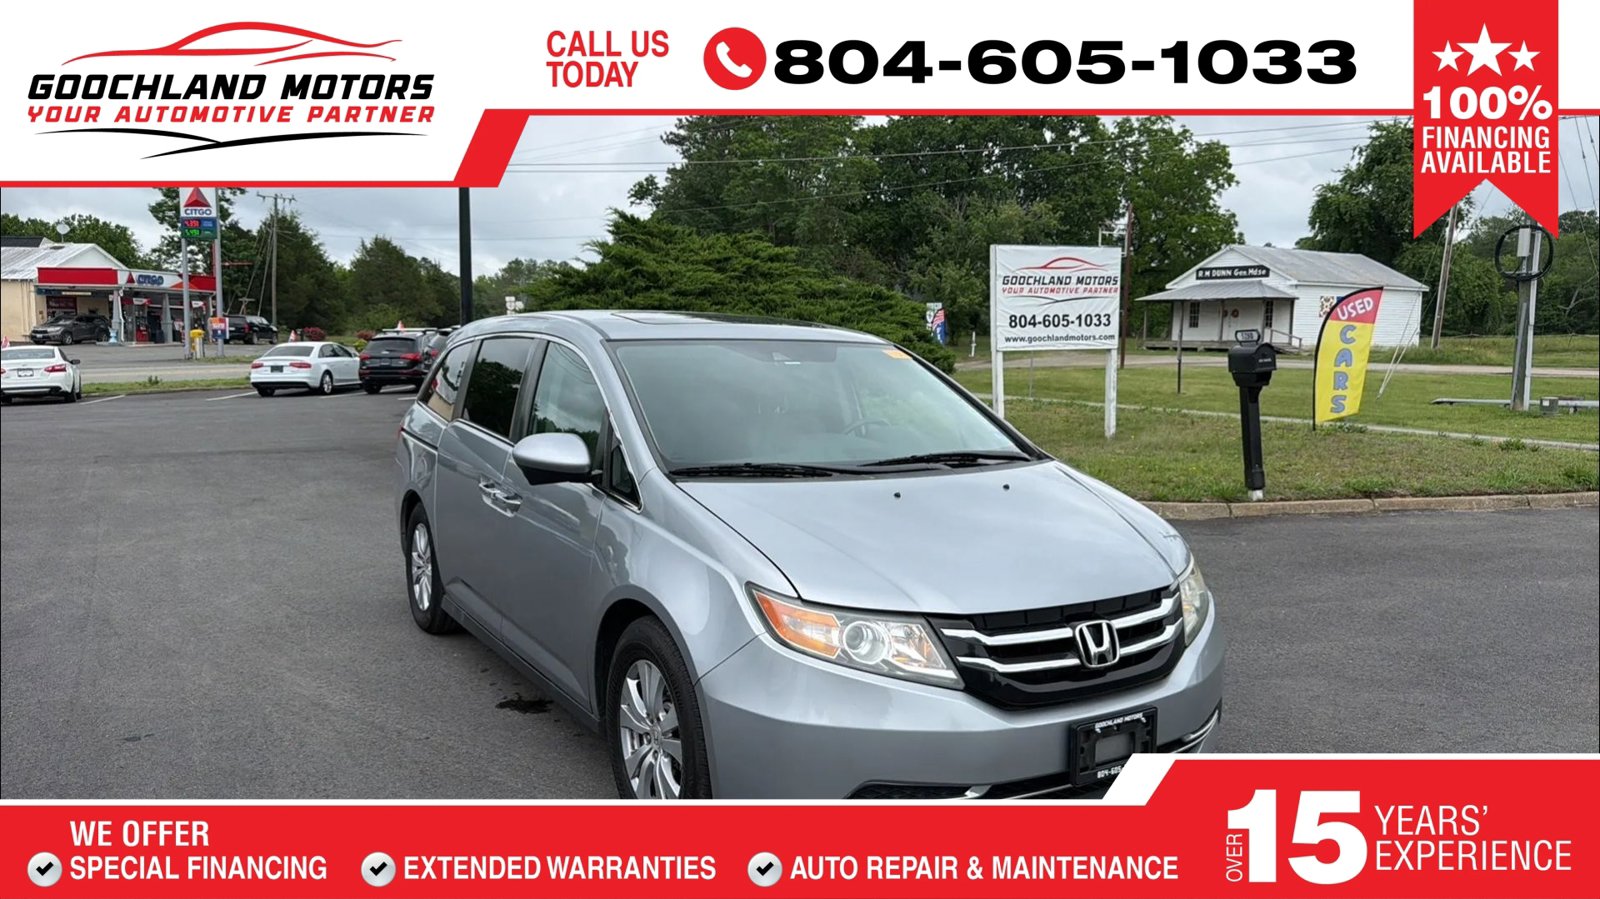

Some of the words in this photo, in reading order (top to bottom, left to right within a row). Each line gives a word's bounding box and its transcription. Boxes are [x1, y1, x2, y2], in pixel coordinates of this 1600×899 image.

[184, 208, 212, 216] CITGO
[1212, 269, 1232, 277] DUNN
[136, 273, 164, 286] CITGO
[1002, 275, 1072, 286] GOOCHLAND
[1075, 275, 1119, 286] MOTORS
[1002, 286, 1024, 294] YOUR
[1028, 286, 1079, 294] AUTOMOTIVE
[1083, 286, 1119, 294] PARTNER
[1337, 296, 1374, 320] USED
[1008, 313, 1112, 328] 804-605-1033
[1004, 333, 1116, 345] www.goochlandmotors.com
[1330, 324, 1356, 413] CARS
[1097, 765, 1122, 779] 804-605
